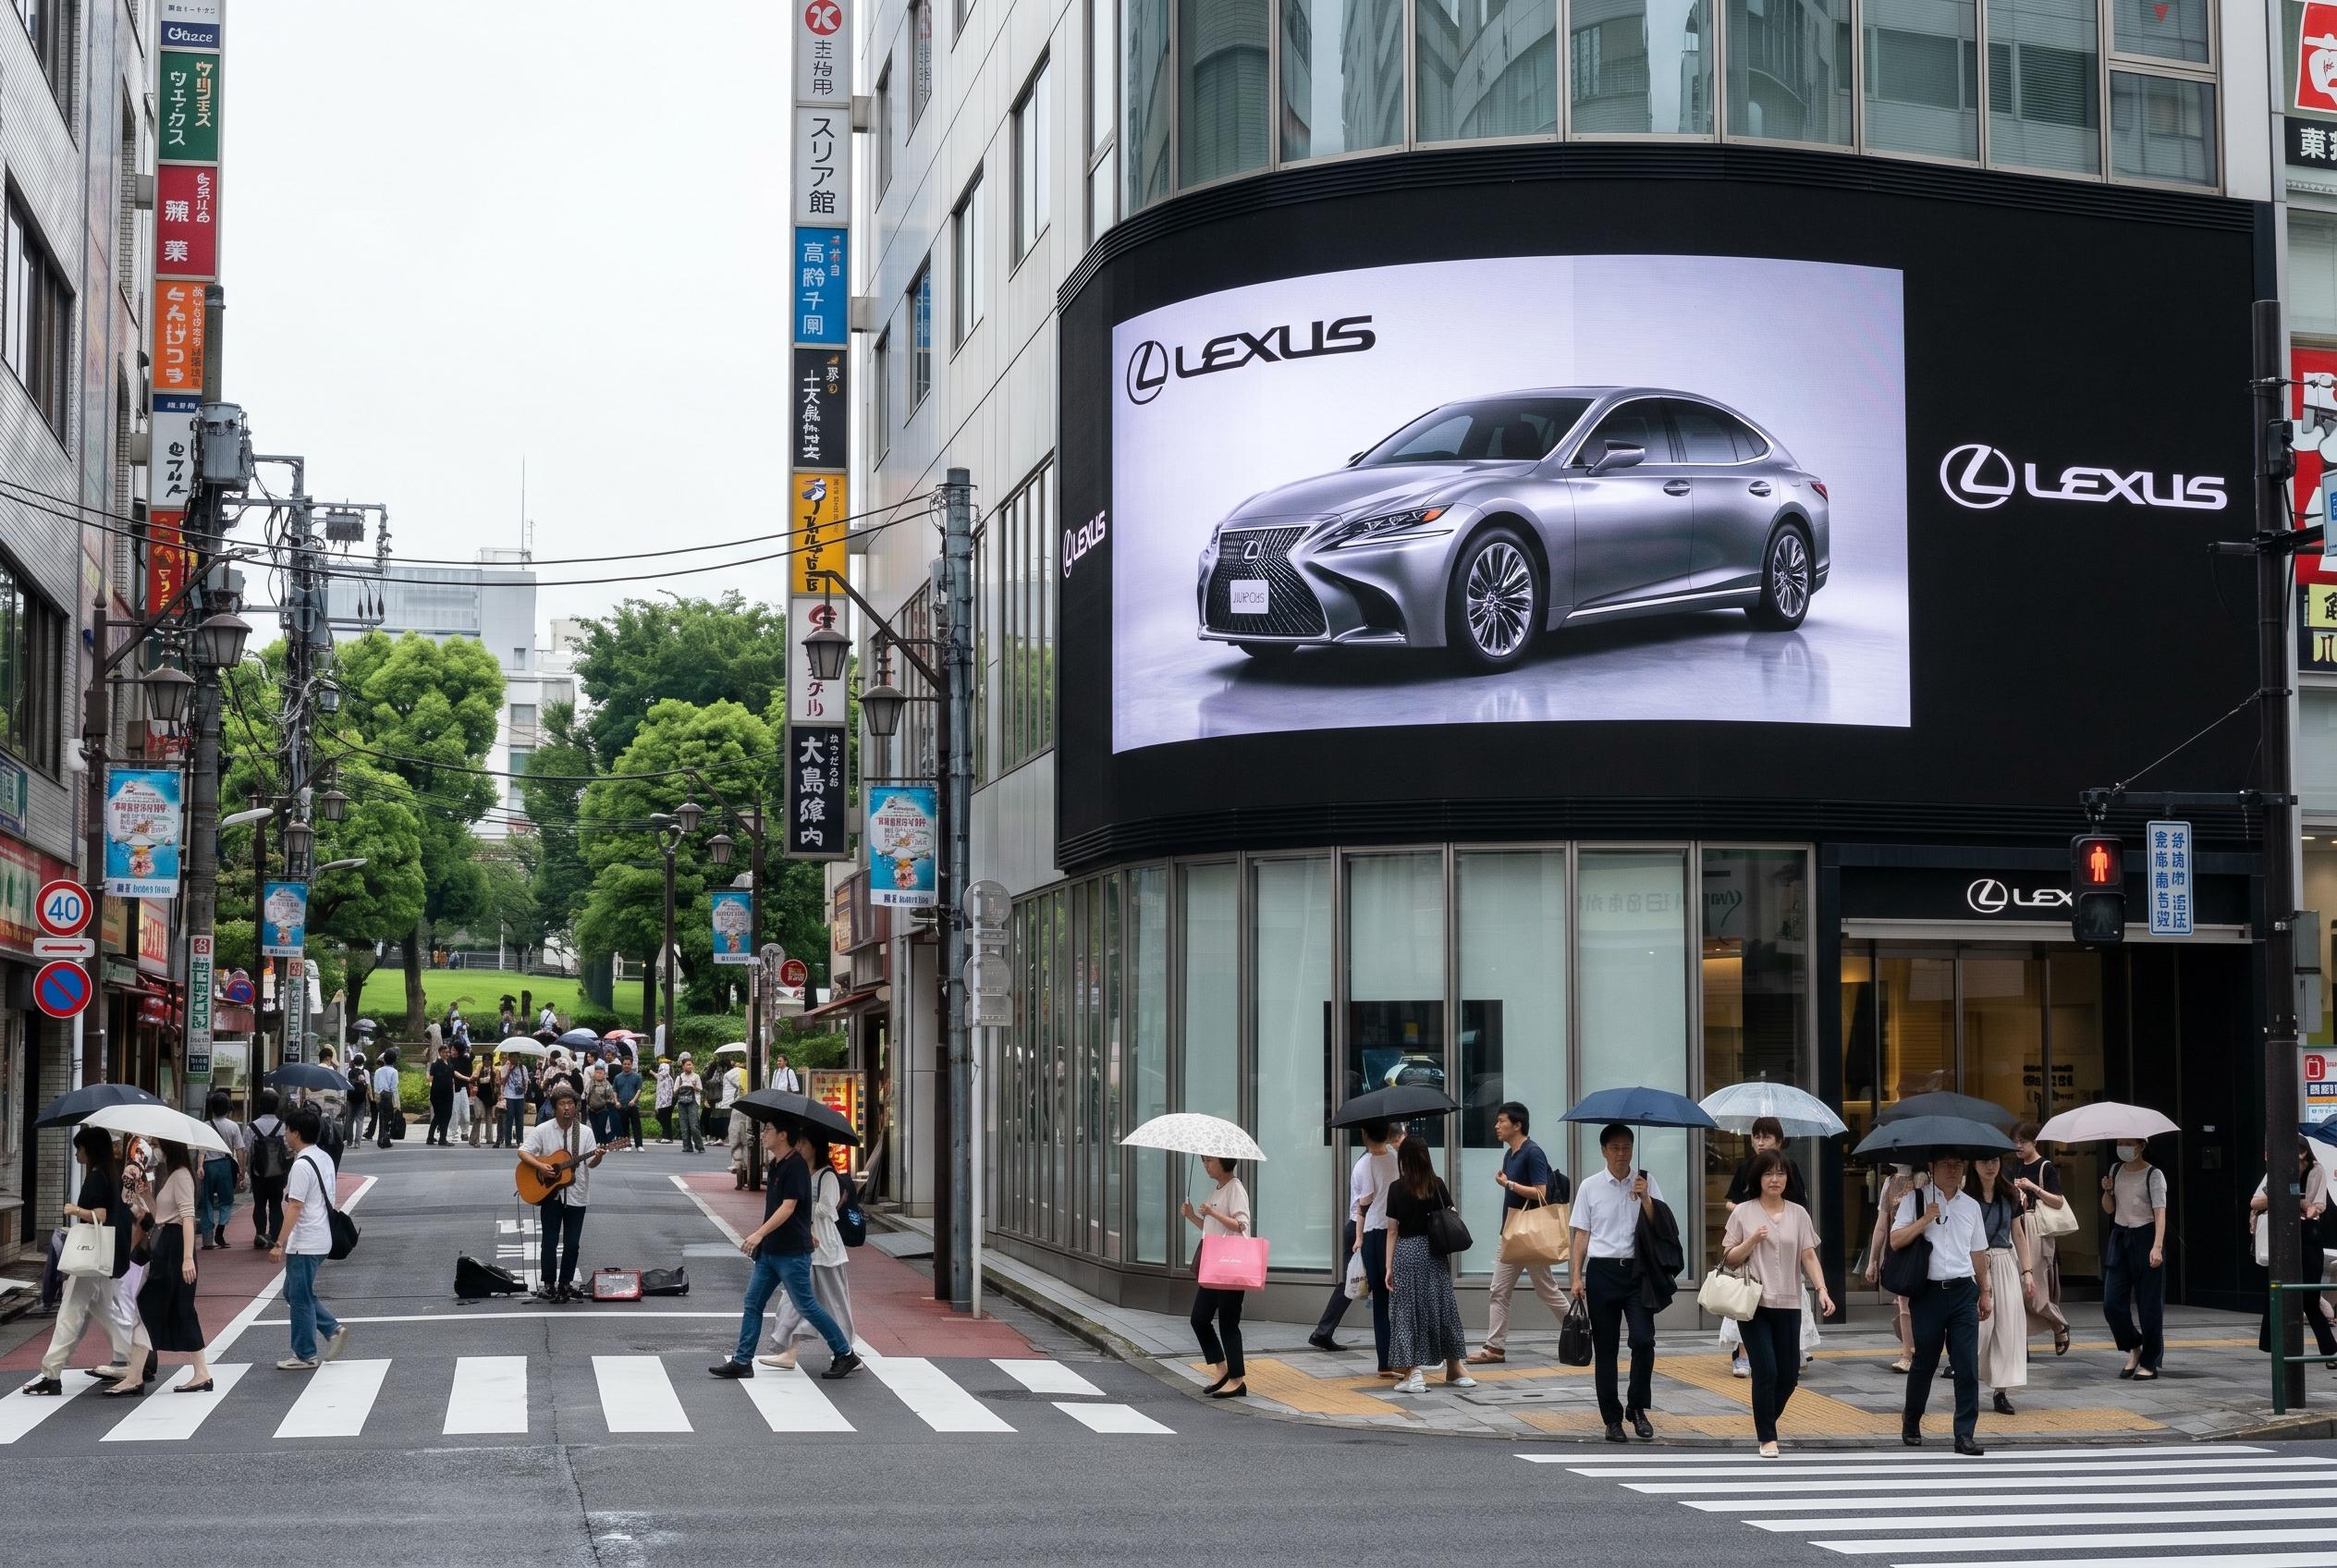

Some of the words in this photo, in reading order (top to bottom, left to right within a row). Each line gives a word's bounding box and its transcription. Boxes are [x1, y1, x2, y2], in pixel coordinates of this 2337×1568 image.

[809, 117, 836, 214] スリア館
[1175, 314, 1377, 379] LEXUS
[2025, 462, 2228, 510] LEXUS
[1072, 509, 1107, 561] LEXUS
[47, 896, 80, 922] 40
[2013, 888, 2073, 907] LEX
